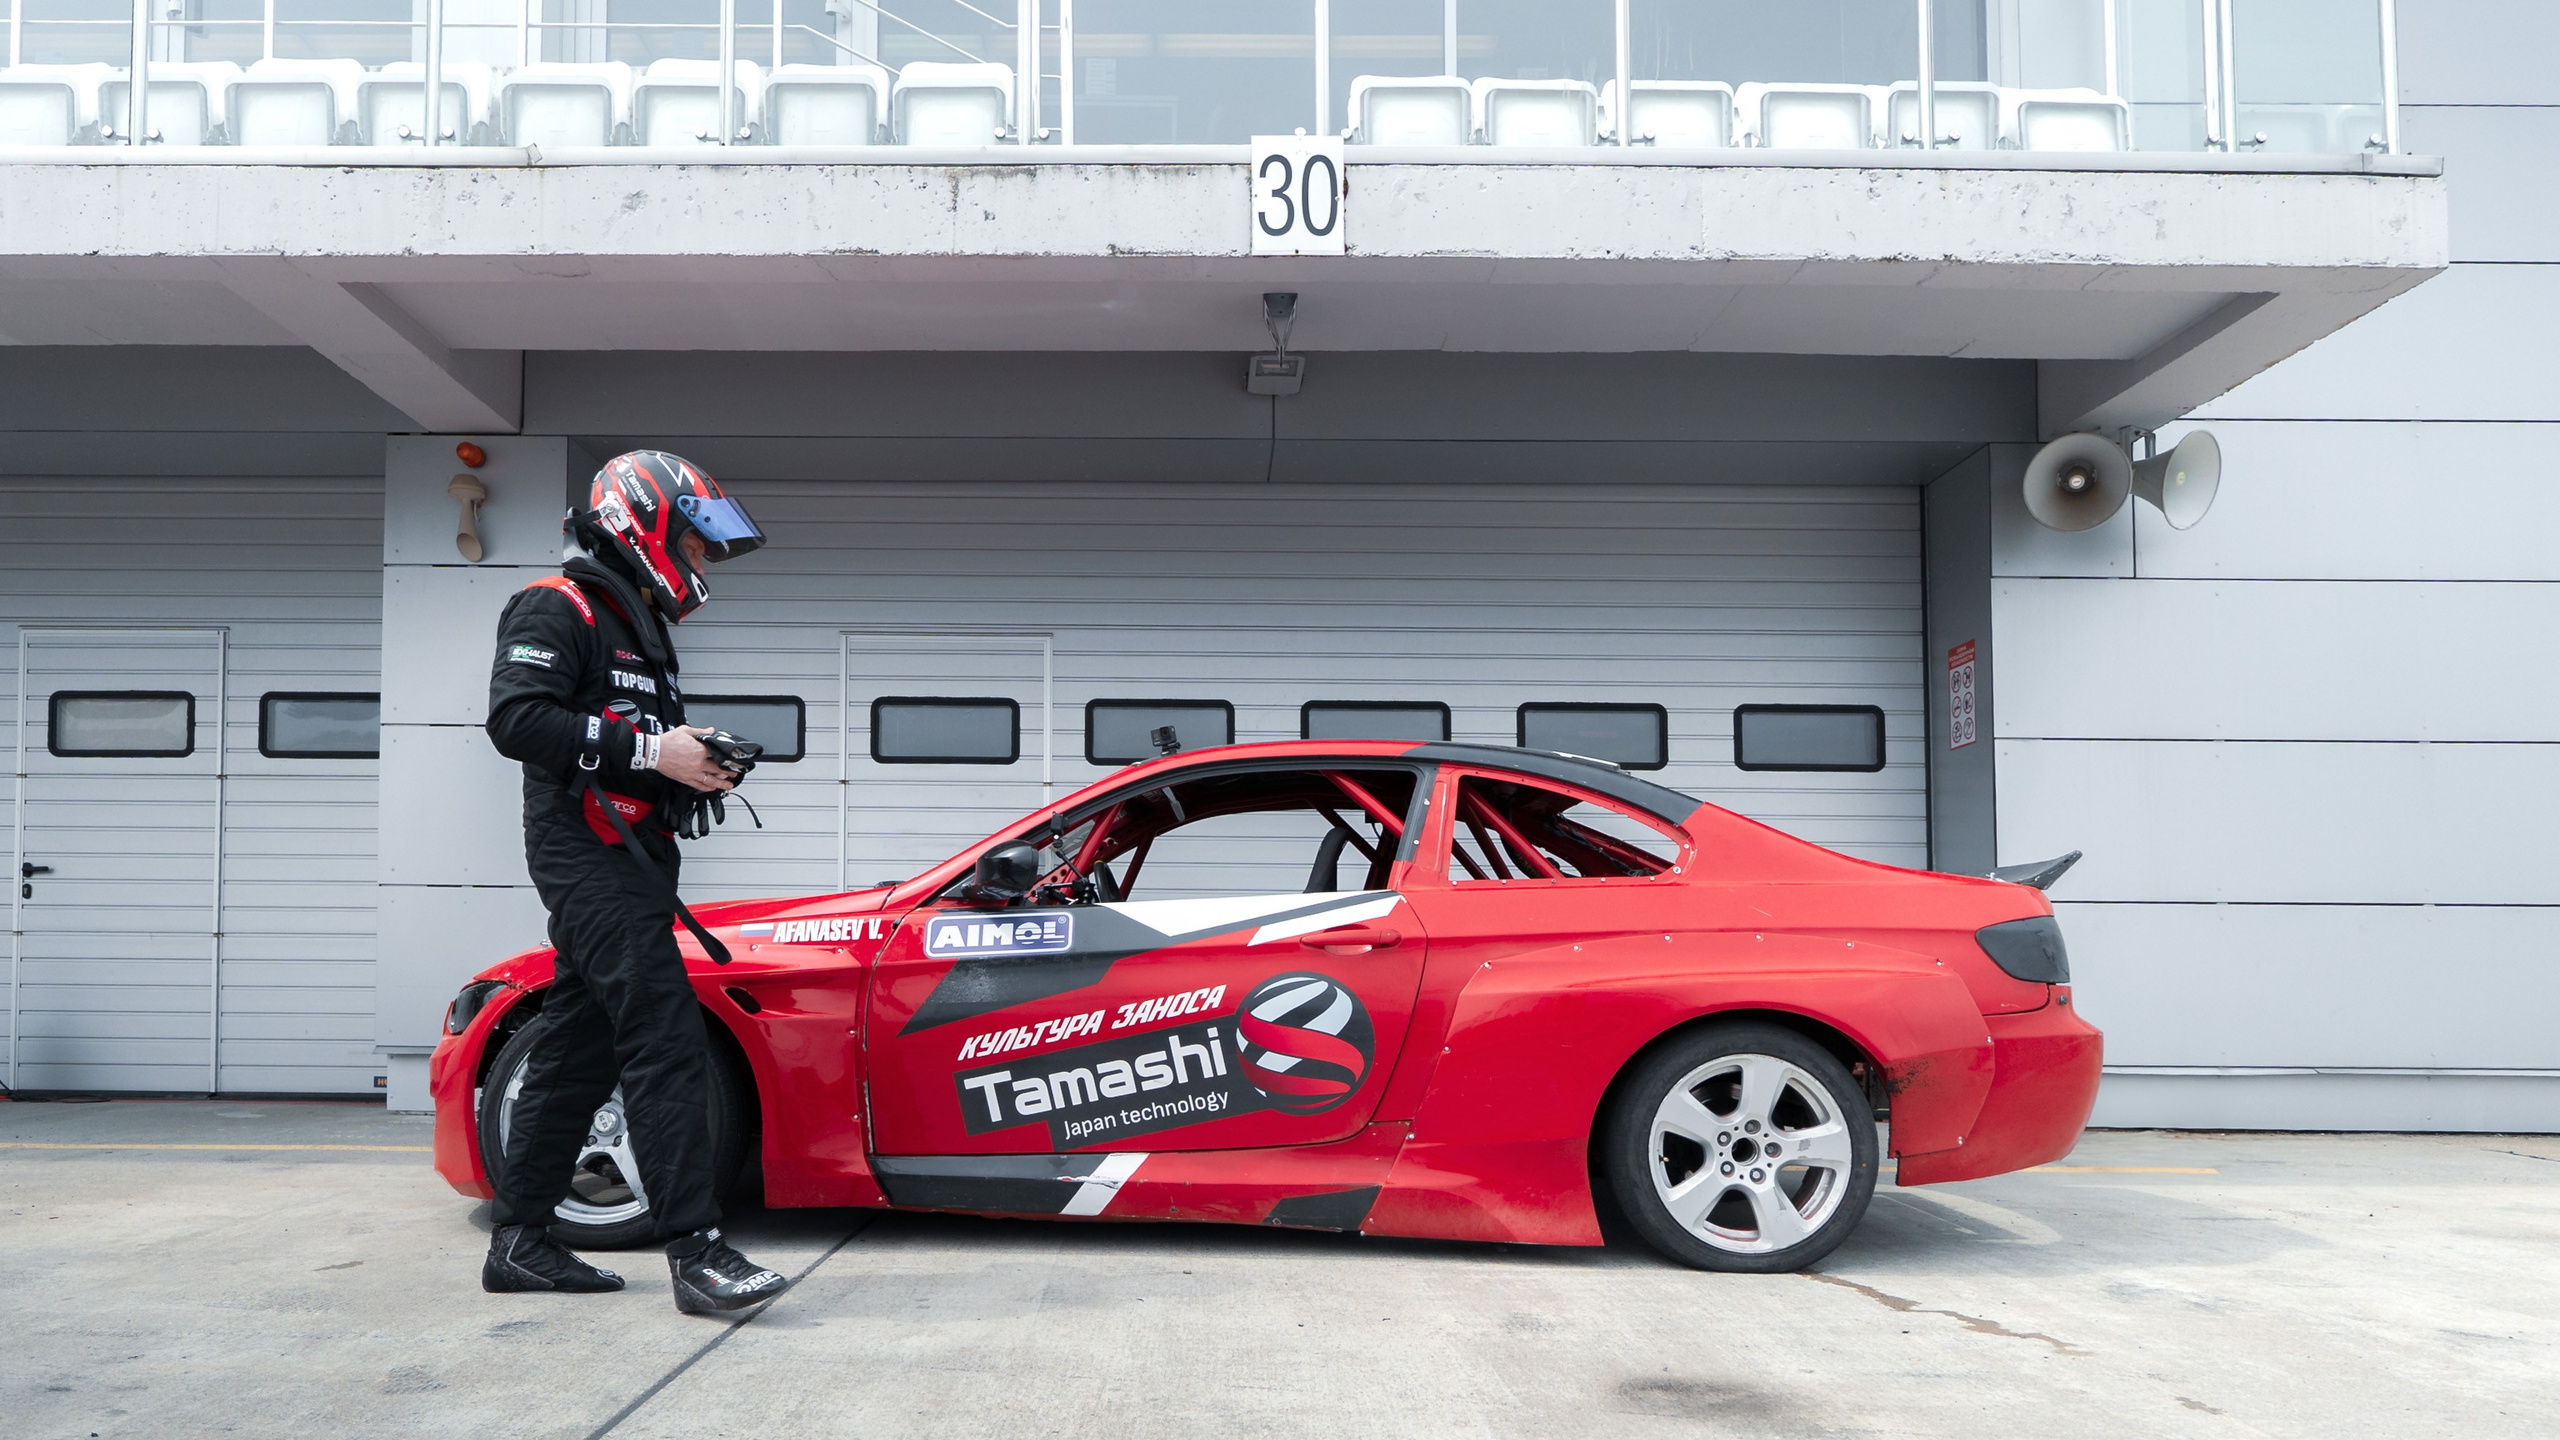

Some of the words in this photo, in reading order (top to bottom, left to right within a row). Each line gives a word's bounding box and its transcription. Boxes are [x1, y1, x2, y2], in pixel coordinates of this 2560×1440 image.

[1257, 153, 1339, 237] 30
[625, 468, 657, 512] Tamashi
[611, 669, 657, 695] TOPGUN
[771, 917, 866, 944] AFANASEV
[867, 917, 884, 940] V.
[931, 921, 1066, 949] AIMOL
[957, 1009, 1106, 1062] КУЛЬТУРА
[1111, 984, 1227, 1030] ЗАНОСА
[963, 1026, 1228, 1123] Tamashi
[1064, 1112, 1118, 1140] Japan
[1119, 1091, 1229, 1125] technology
[736, 1269, 777, 1295] OMP
